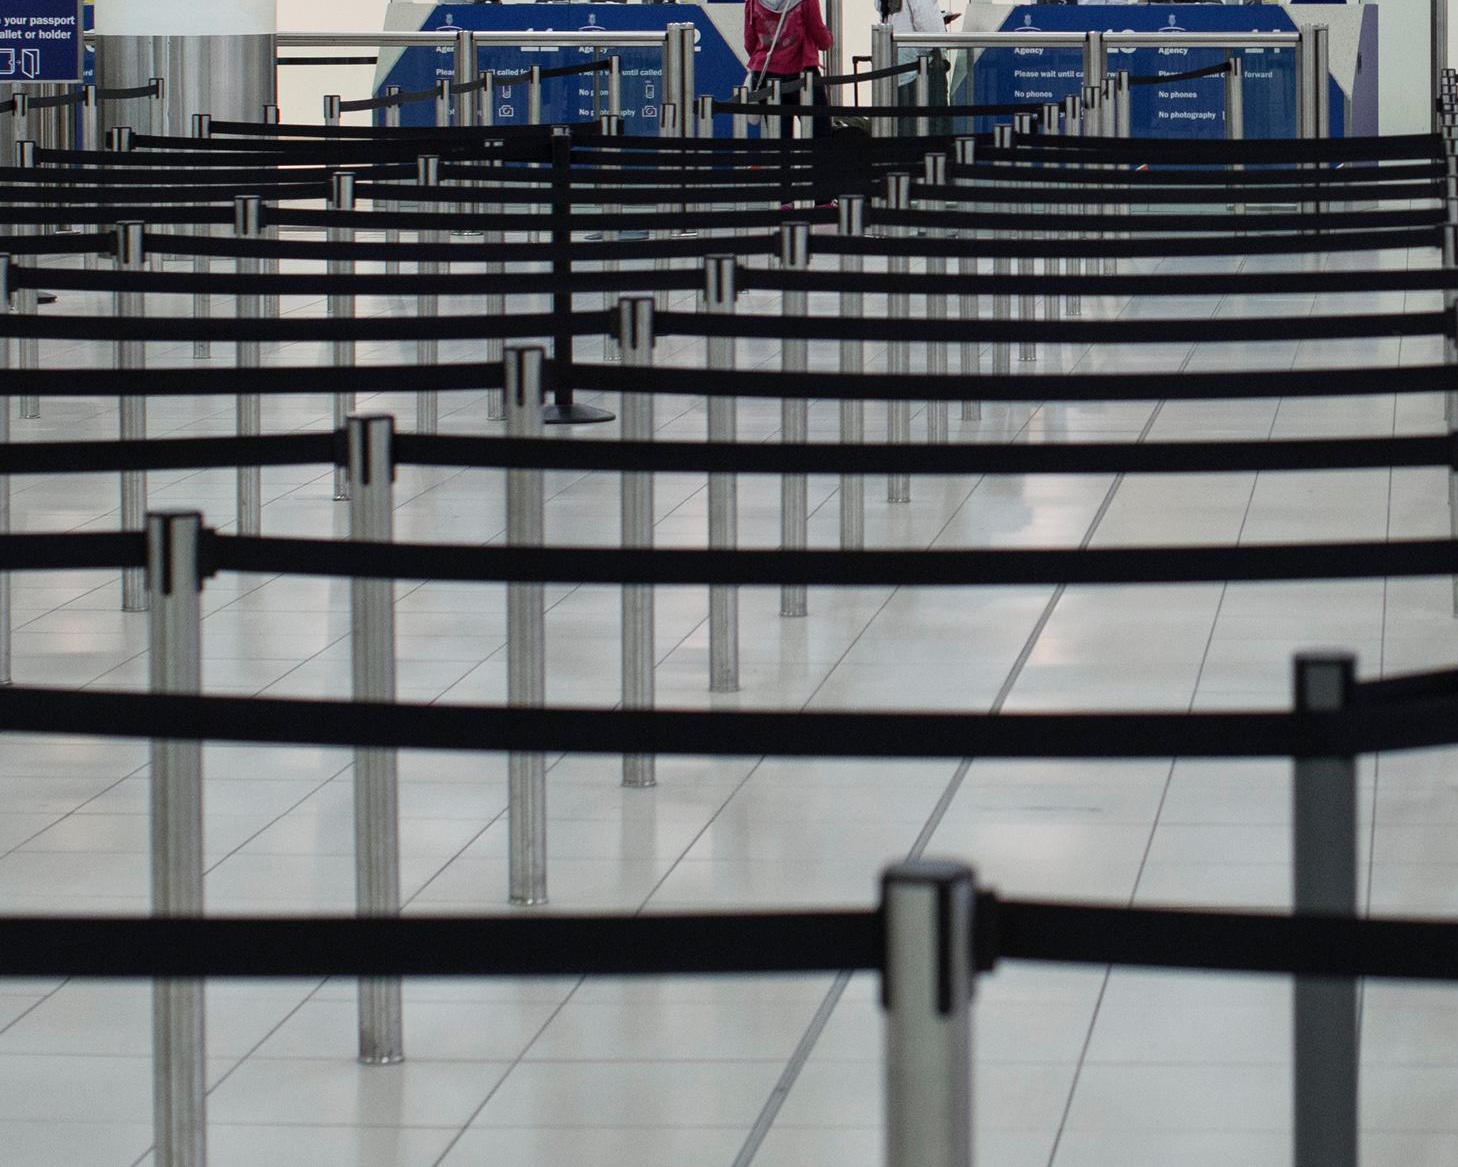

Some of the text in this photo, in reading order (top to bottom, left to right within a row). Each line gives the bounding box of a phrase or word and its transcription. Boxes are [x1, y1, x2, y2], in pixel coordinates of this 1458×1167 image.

[4, 17, 27, 26] your
[30, 16, 75, 26] passport
[0, 30, 22, 39] allet
[39, 30, 71, 39] holder
[1014, 47, 1044, 55] Agency
[1158, 47, 1189, 56] Agency
[1014, 90, 1053, 99] No phones
[1170, 91, 1197, 99] phones
[1158, 111, 1217, 120] No photography
